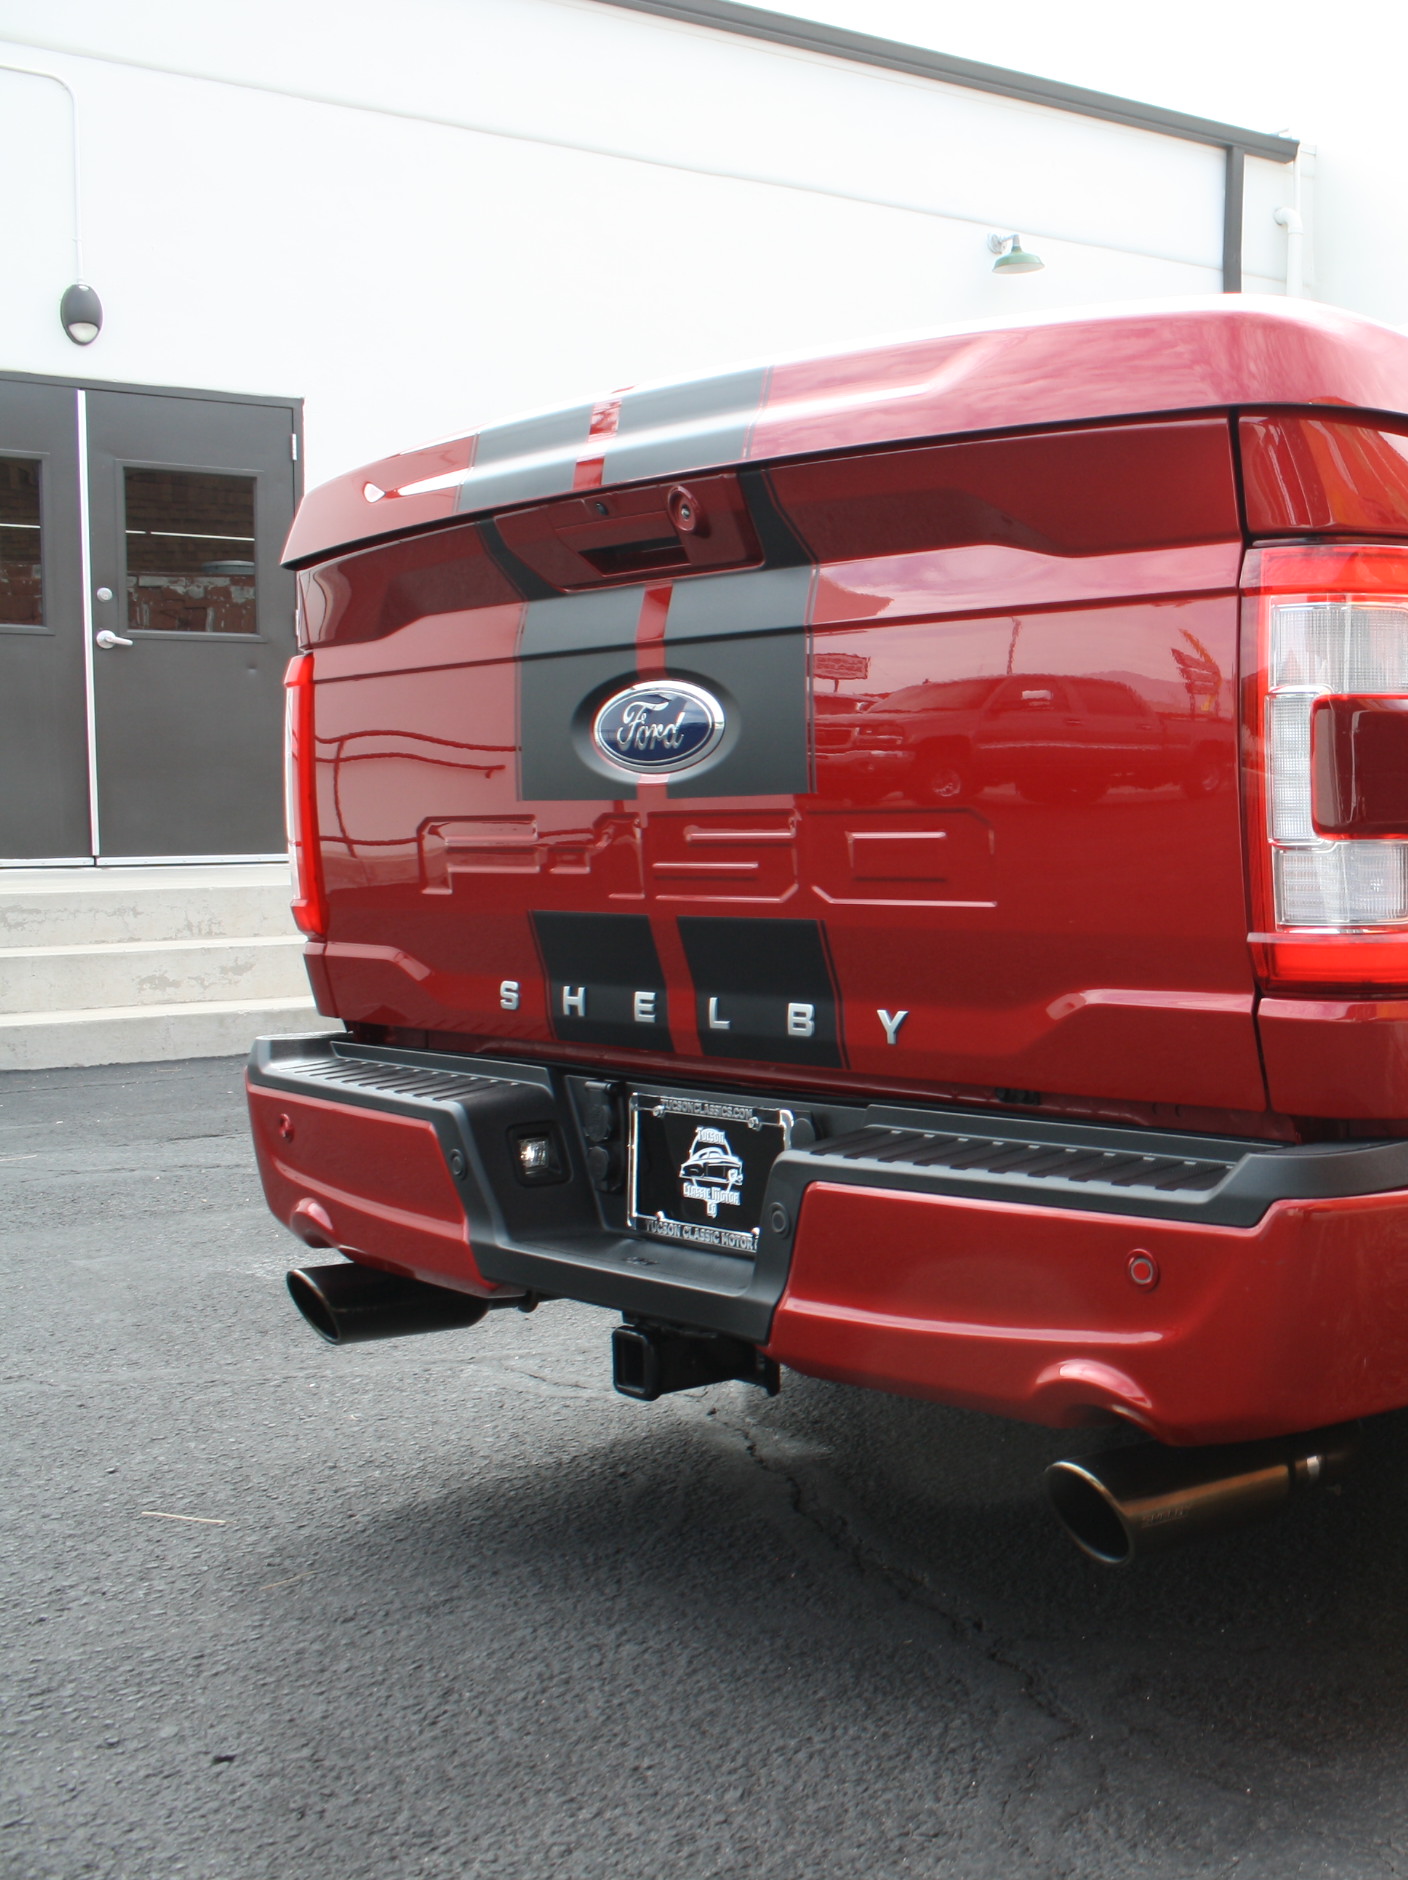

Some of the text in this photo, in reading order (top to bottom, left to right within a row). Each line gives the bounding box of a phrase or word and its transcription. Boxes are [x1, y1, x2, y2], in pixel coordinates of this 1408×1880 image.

[616, 701, 685, 751] Ford
[417, 809, 998, 907] F-150
[499, 979, 909, 1045] SHELBY
[660, 1098, 753, 1120] TUCSONCLASSICS.COM
[645, 1219, 681, 1237] TUCSON
[682, 1225, 720, 1244] CLASSIC
[721, 1231, 753, 1250] MOTOR
